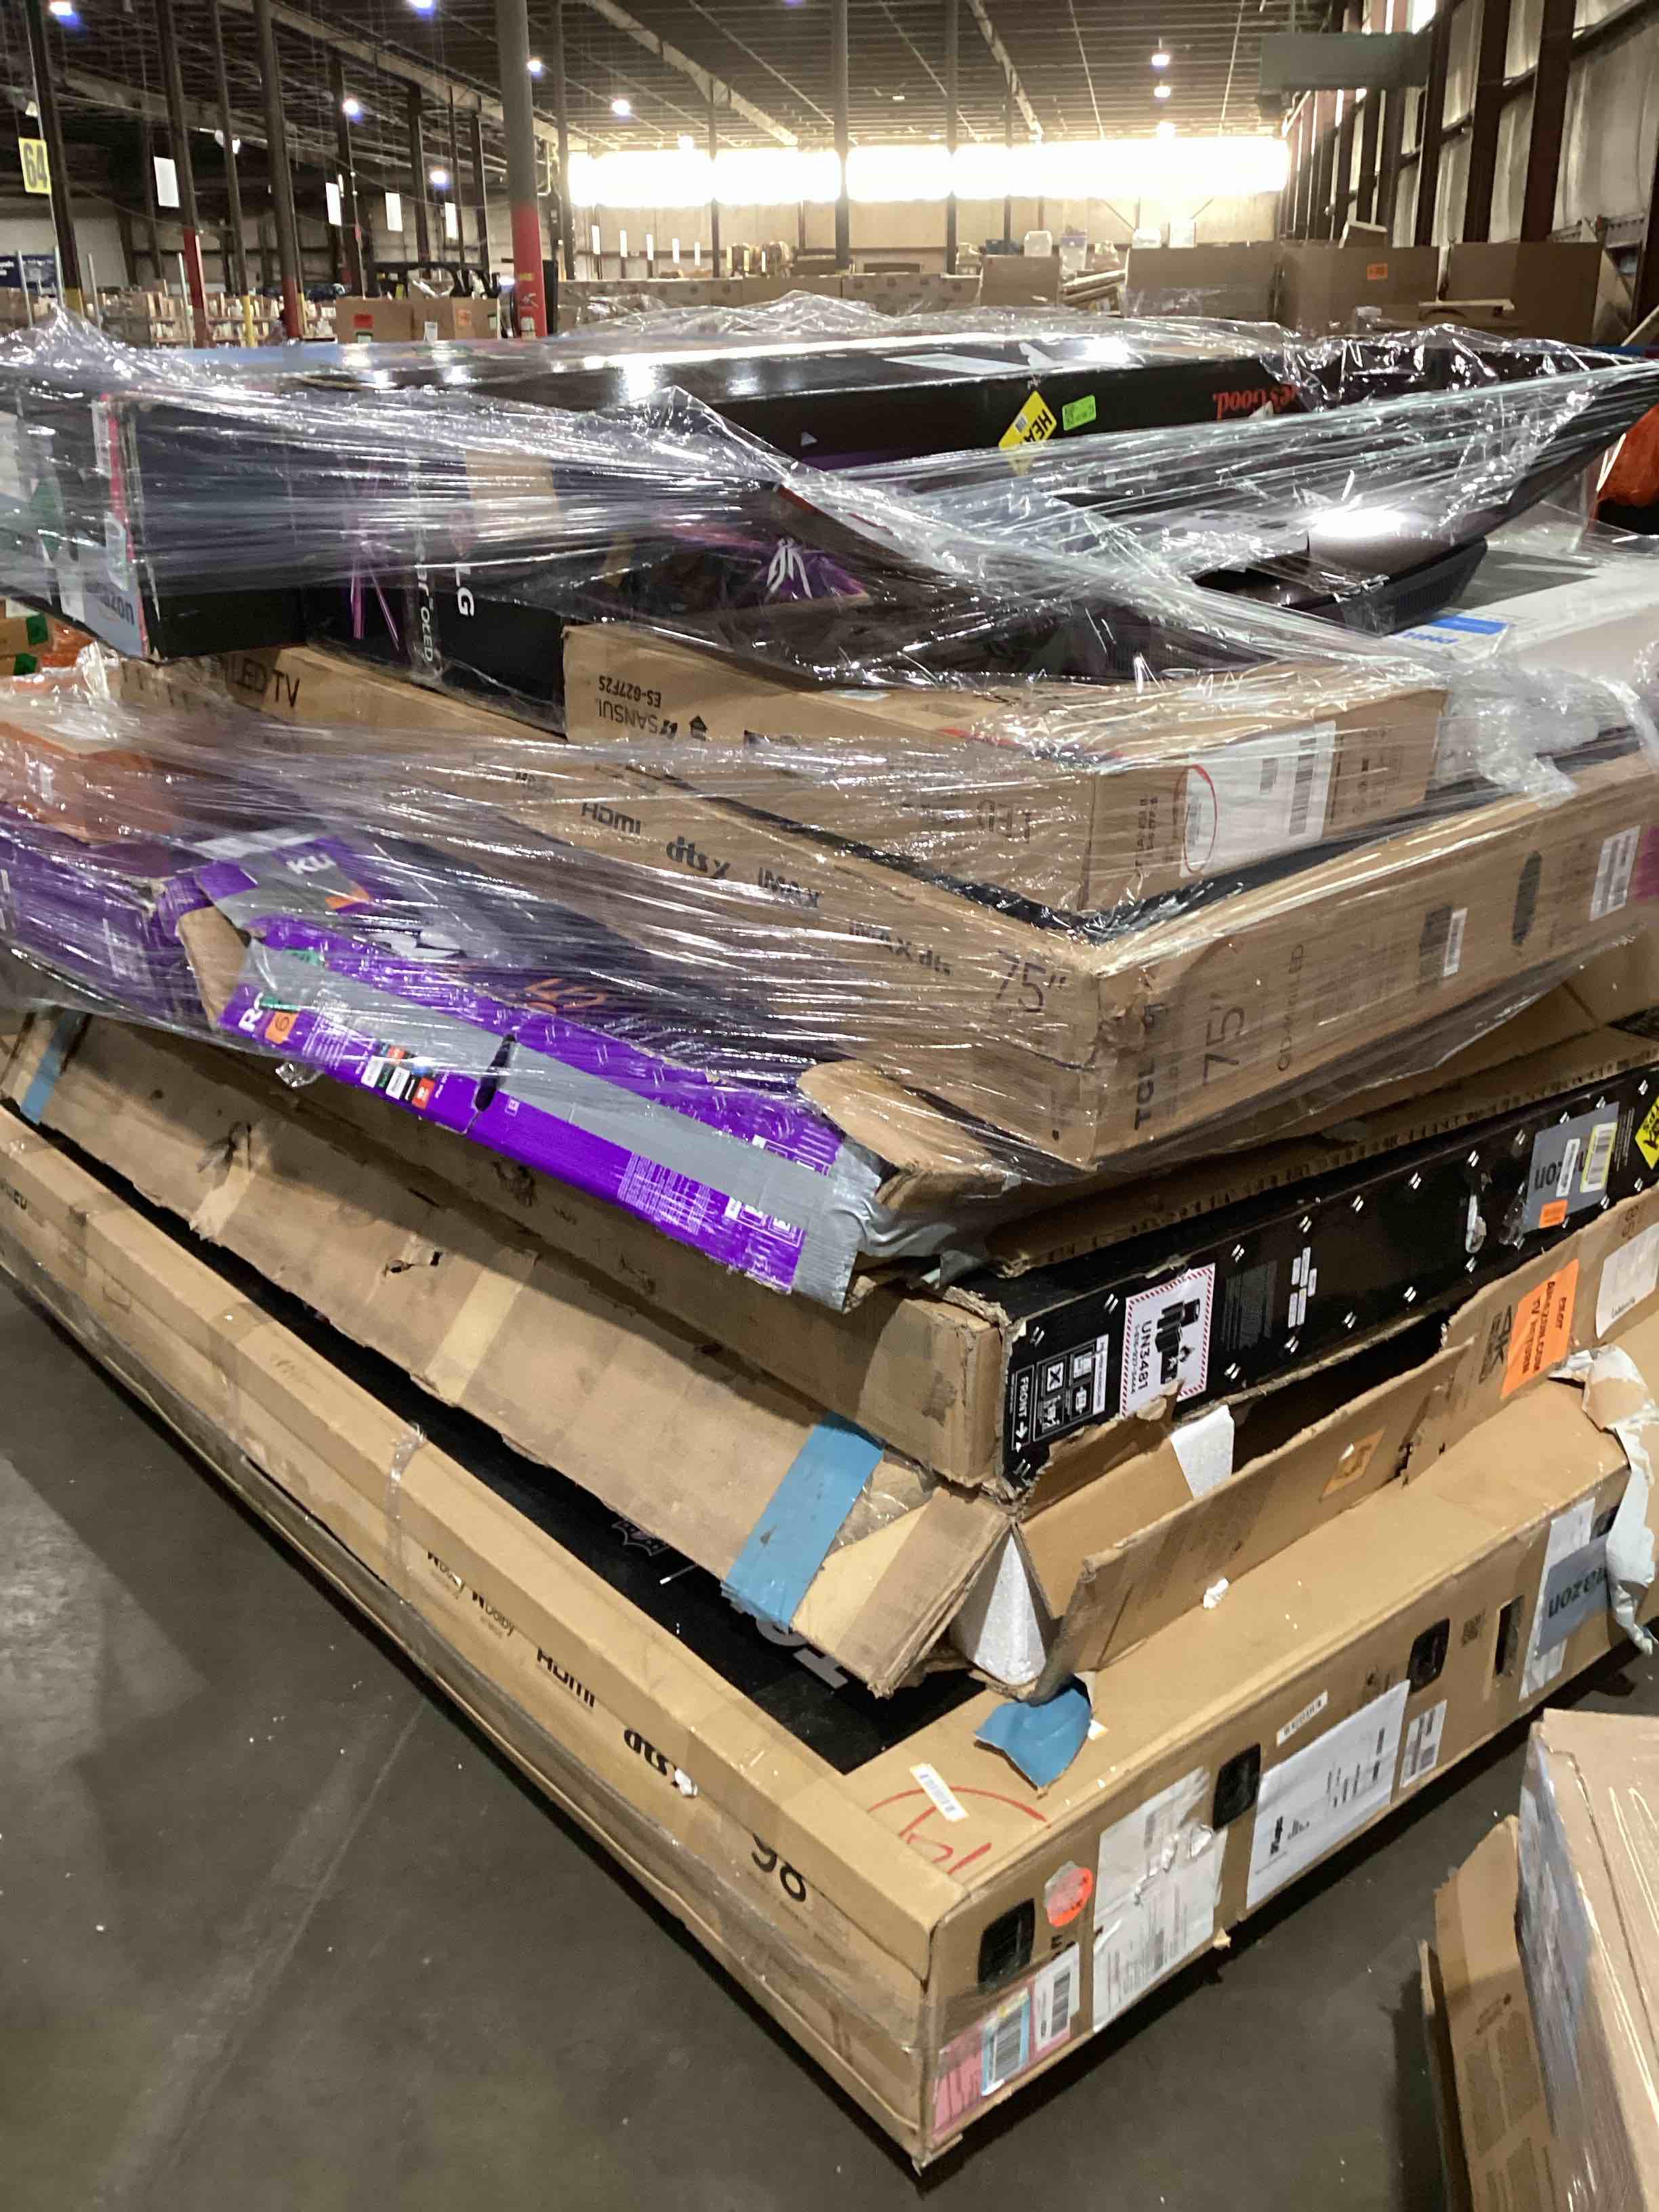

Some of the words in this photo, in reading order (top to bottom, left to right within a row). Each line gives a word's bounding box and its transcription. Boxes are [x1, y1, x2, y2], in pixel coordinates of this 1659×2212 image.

[23, 142, 48, 189] 64
[455, 565, 475, 617] LG
[271, 669, 300, 708] TV
[598, 698, 658, 721] SANSUI
[581, 802, 641, 836] HDMI
[1138, 1319, 1150, 1391] UN3481
[1018, 1376, 1029, 1419] FRONT
